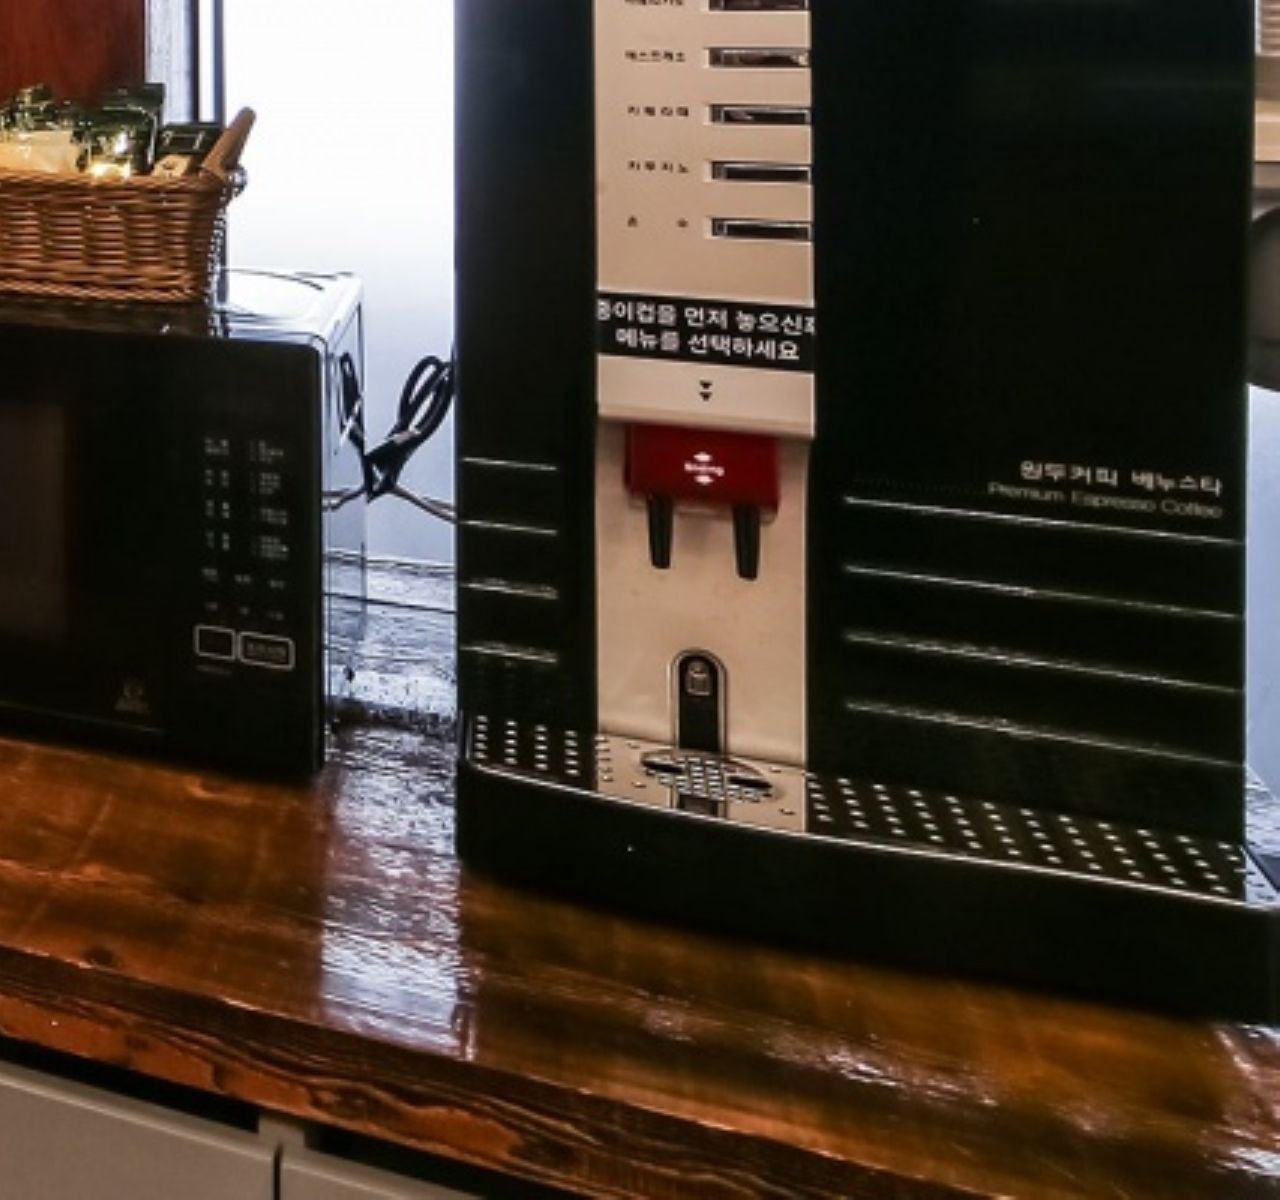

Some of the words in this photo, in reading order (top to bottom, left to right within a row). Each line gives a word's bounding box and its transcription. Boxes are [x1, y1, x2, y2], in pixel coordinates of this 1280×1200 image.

[683, 307, 729, 330] 먼저
[615, 328, 681, 352] 메뉴를
[687, 334, 801, 361] 선택하세요
[1019, 460, 1119, 488] 원두커피
[1130, 469, 1223, 498] 베누스타
[987, 480, 1065, 503] Premium
[1070, 488, 1157, 514] Espresso
[1160, 498, 1223, 519] Coffee
